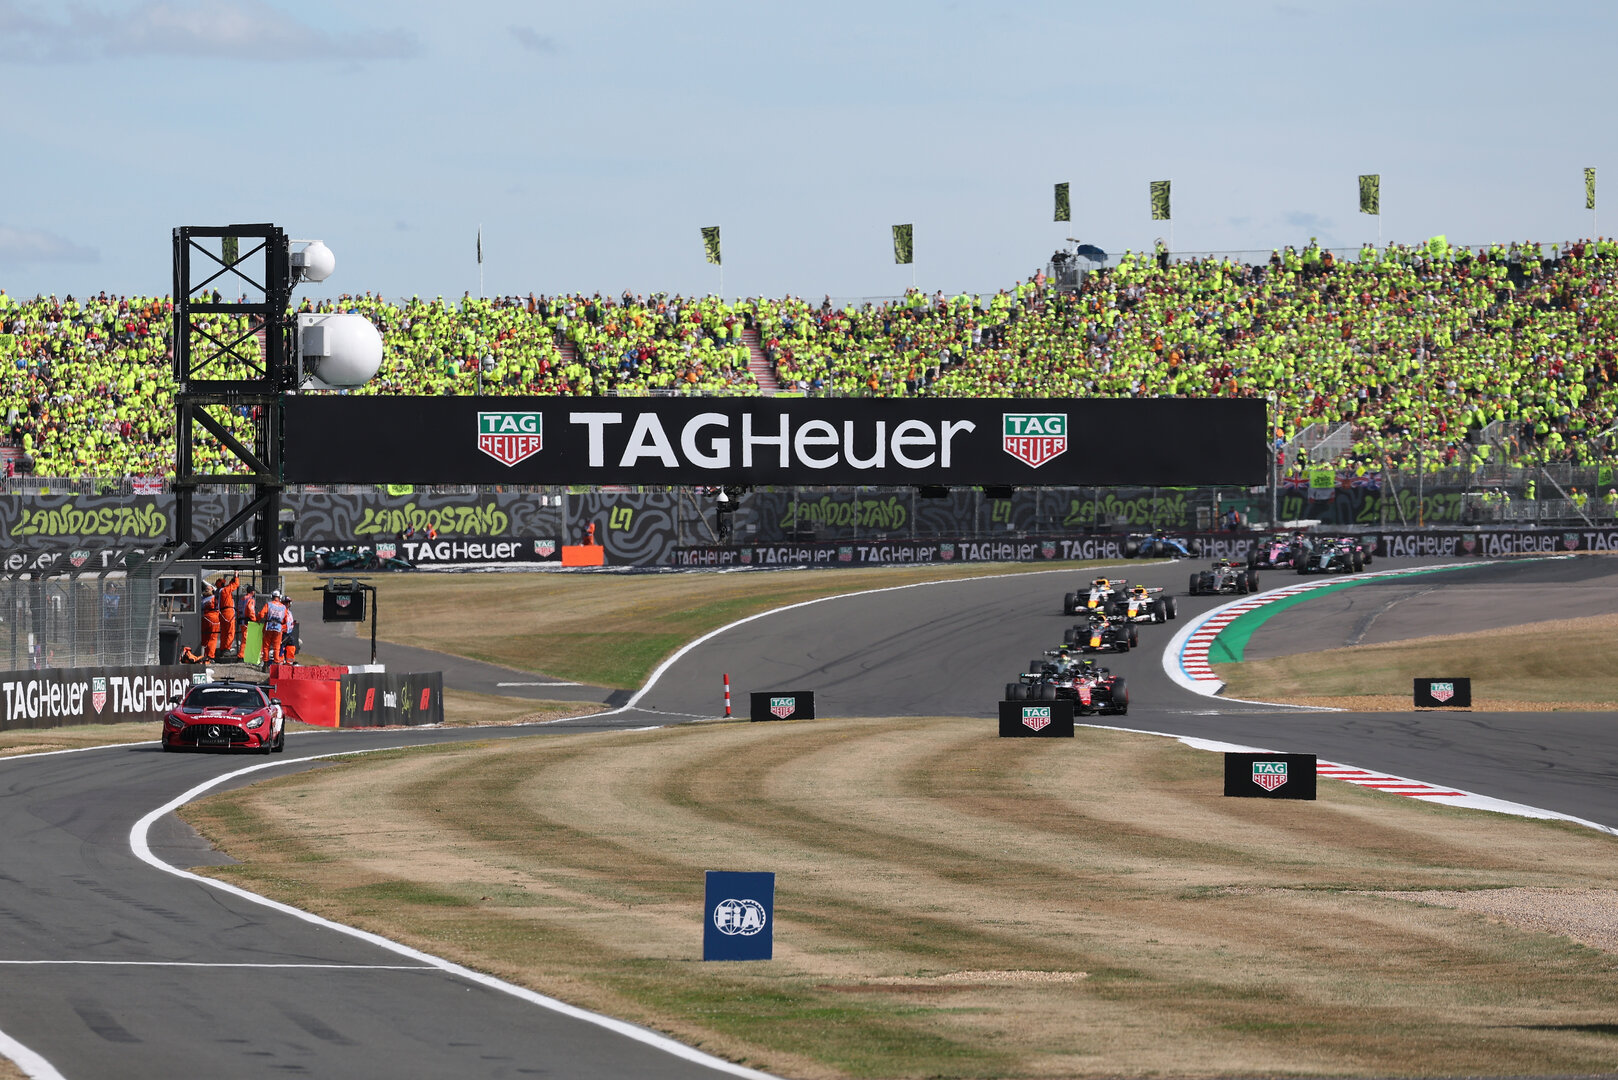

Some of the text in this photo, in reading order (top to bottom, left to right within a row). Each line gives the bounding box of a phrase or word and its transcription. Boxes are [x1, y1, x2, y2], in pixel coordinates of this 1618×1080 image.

[483, 415, 537, 432] TAG
[1008, 417, 1062, 434] TAG
[481, 436, 539, 463] HEUER
[1007, 438, 1064, 464] HEUER
[10, 503, 167, 537] LANDOSTAND
[354, 502, 508, 536] LANDOSTAND
[93, 679, 105, 691] TAG
[1024, 708, 1049, 716] TAG
[1024, 717, 1050, 730] HEUER
[1255, 763, 1284, 773] TAG
[1254, 774, 1286, 789] HEUER
